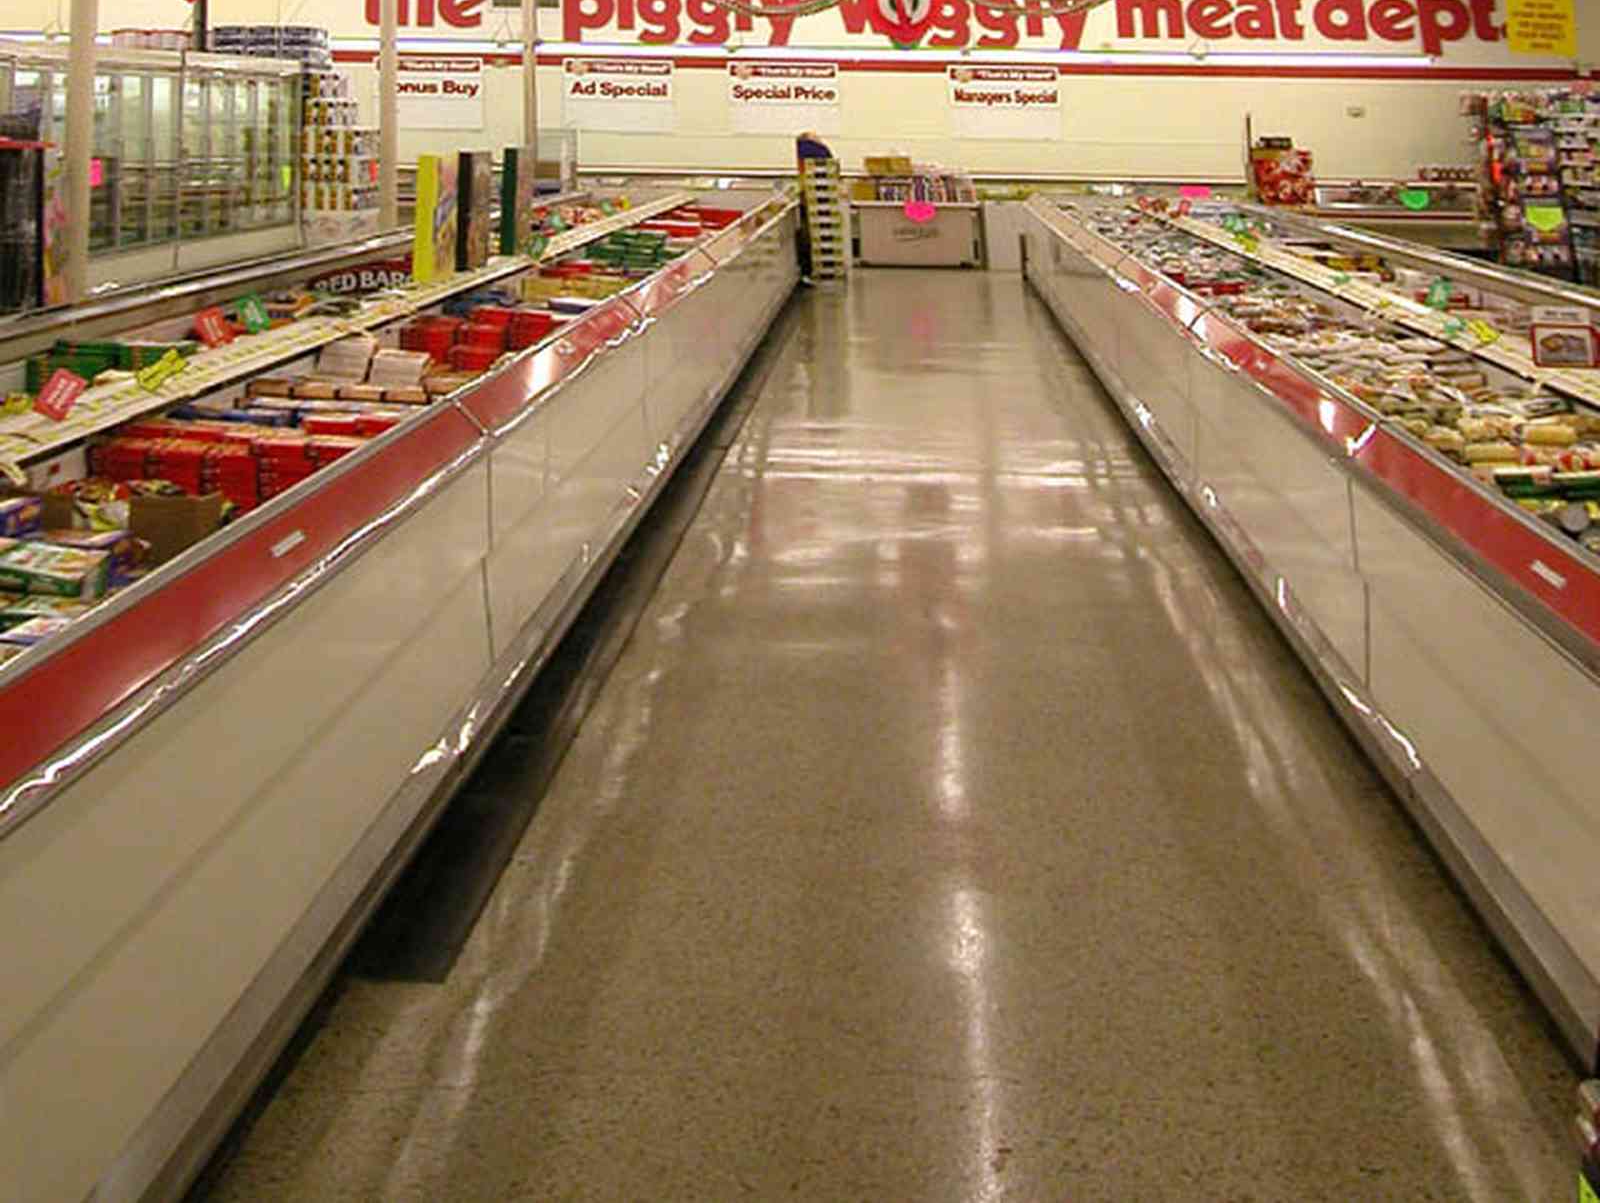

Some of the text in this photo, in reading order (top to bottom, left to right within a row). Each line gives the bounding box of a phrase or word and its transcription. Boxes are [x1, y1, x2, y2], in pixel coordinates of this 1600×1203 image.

[442, 80, 479, 98] Buy
[571, 81, 668, 98] Ad Special
[733, 85, 835, 102] Special Price
[1015, 90, 1058, 105] Special
